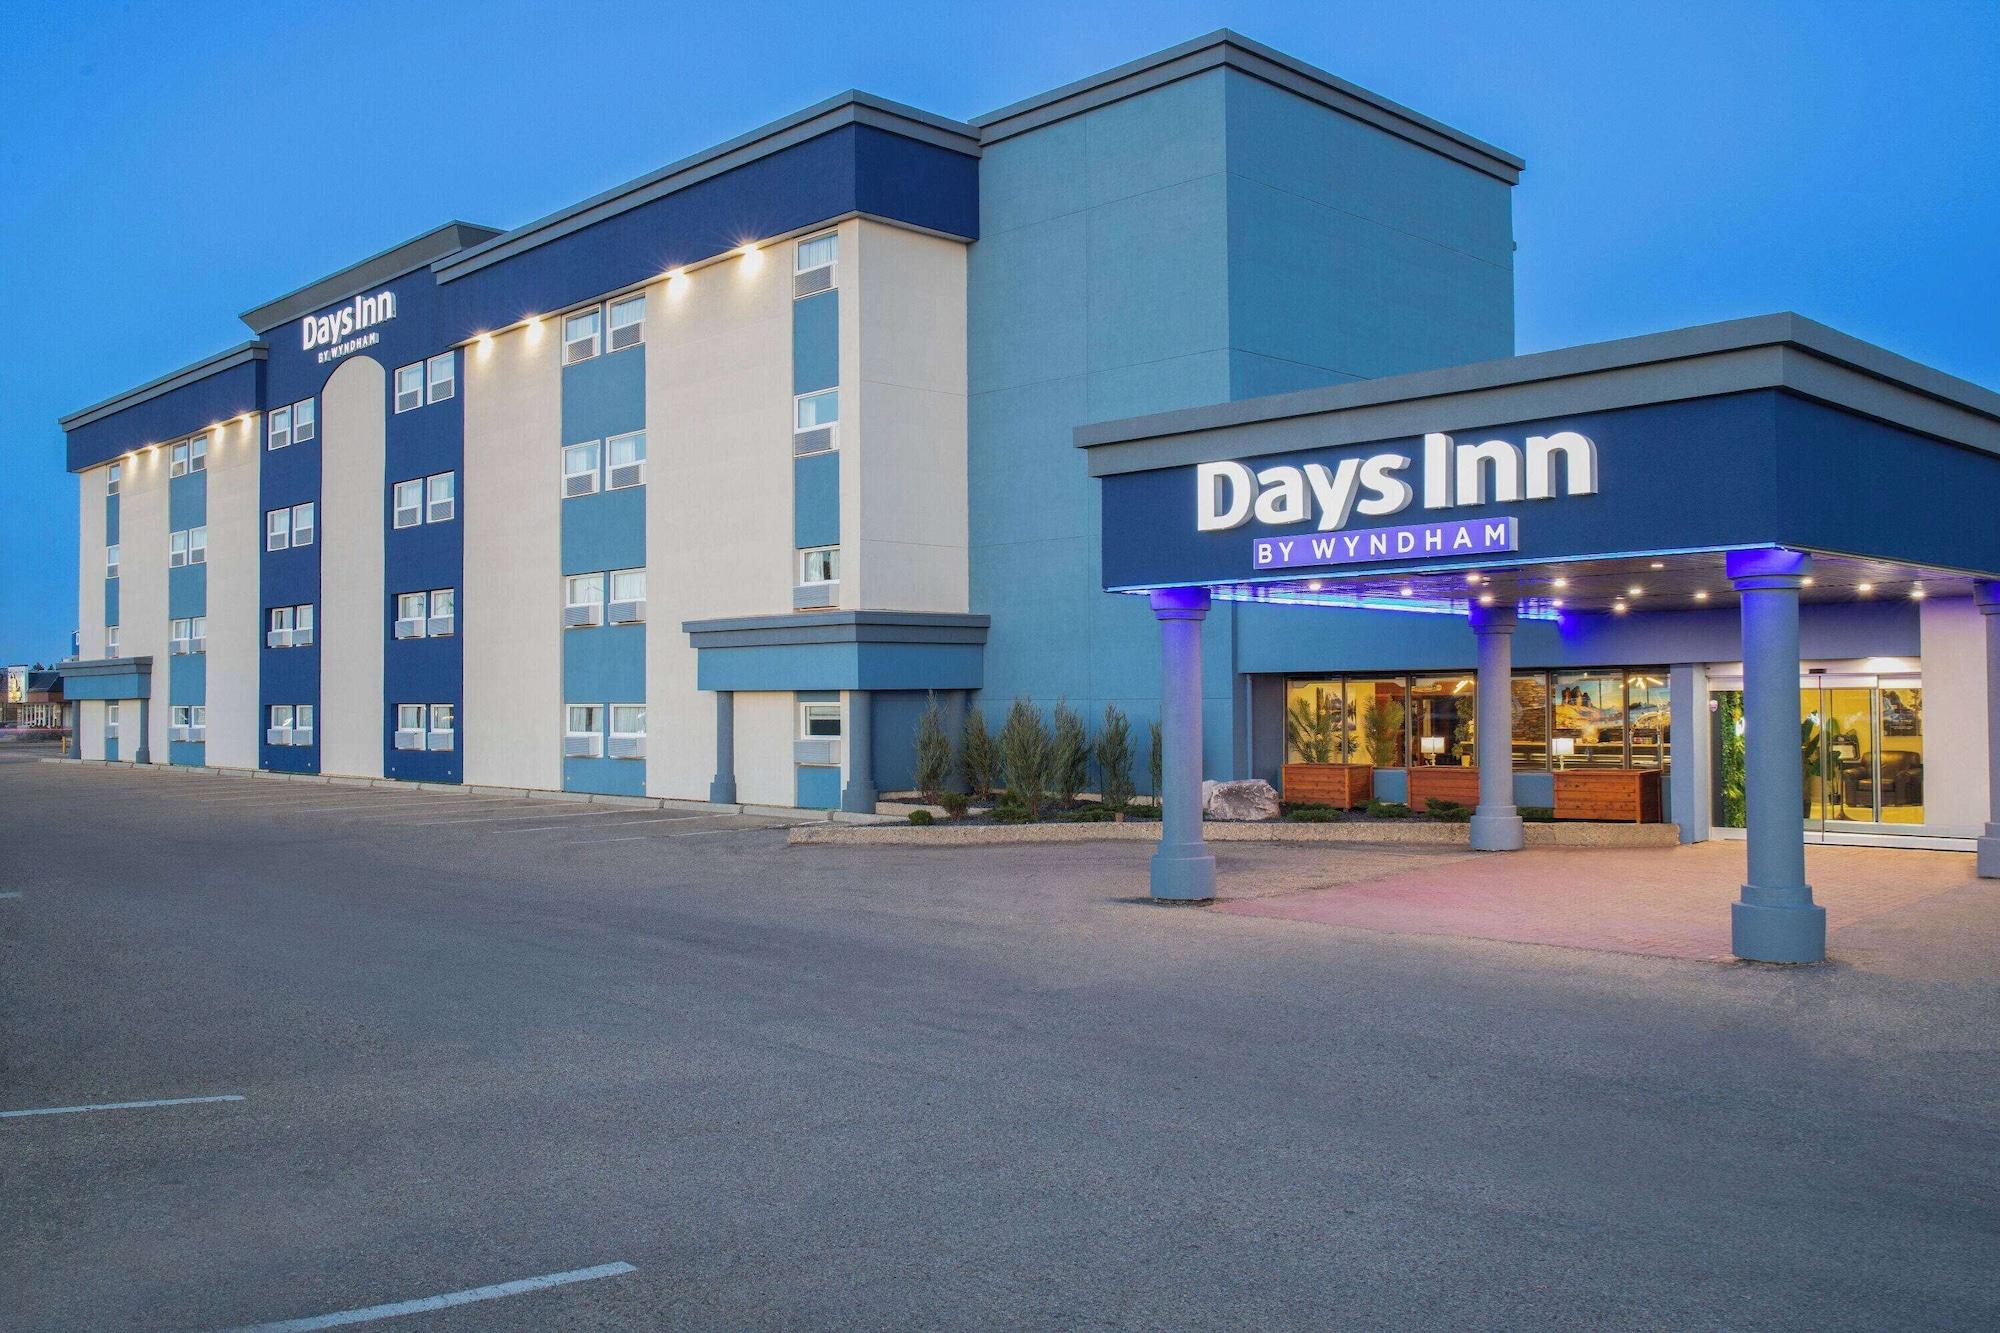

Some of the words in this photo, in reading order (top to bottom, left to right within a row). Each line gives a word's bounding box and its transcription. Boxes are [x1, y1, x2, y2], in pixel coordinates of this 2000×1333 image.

[303, 306, 353, 351] Days
[355, 291, 396, 330] Inn
[318, 350, 330, 364] BY
[331, 332, 379, 359] WYNDHAM
[1197, 453, 1413, 532] Days
[1424, 431, 1598, 510] Inn
[1258, 541, 1294, 564] BY
[1311, 523, 1505, 560] WYNDHAM
